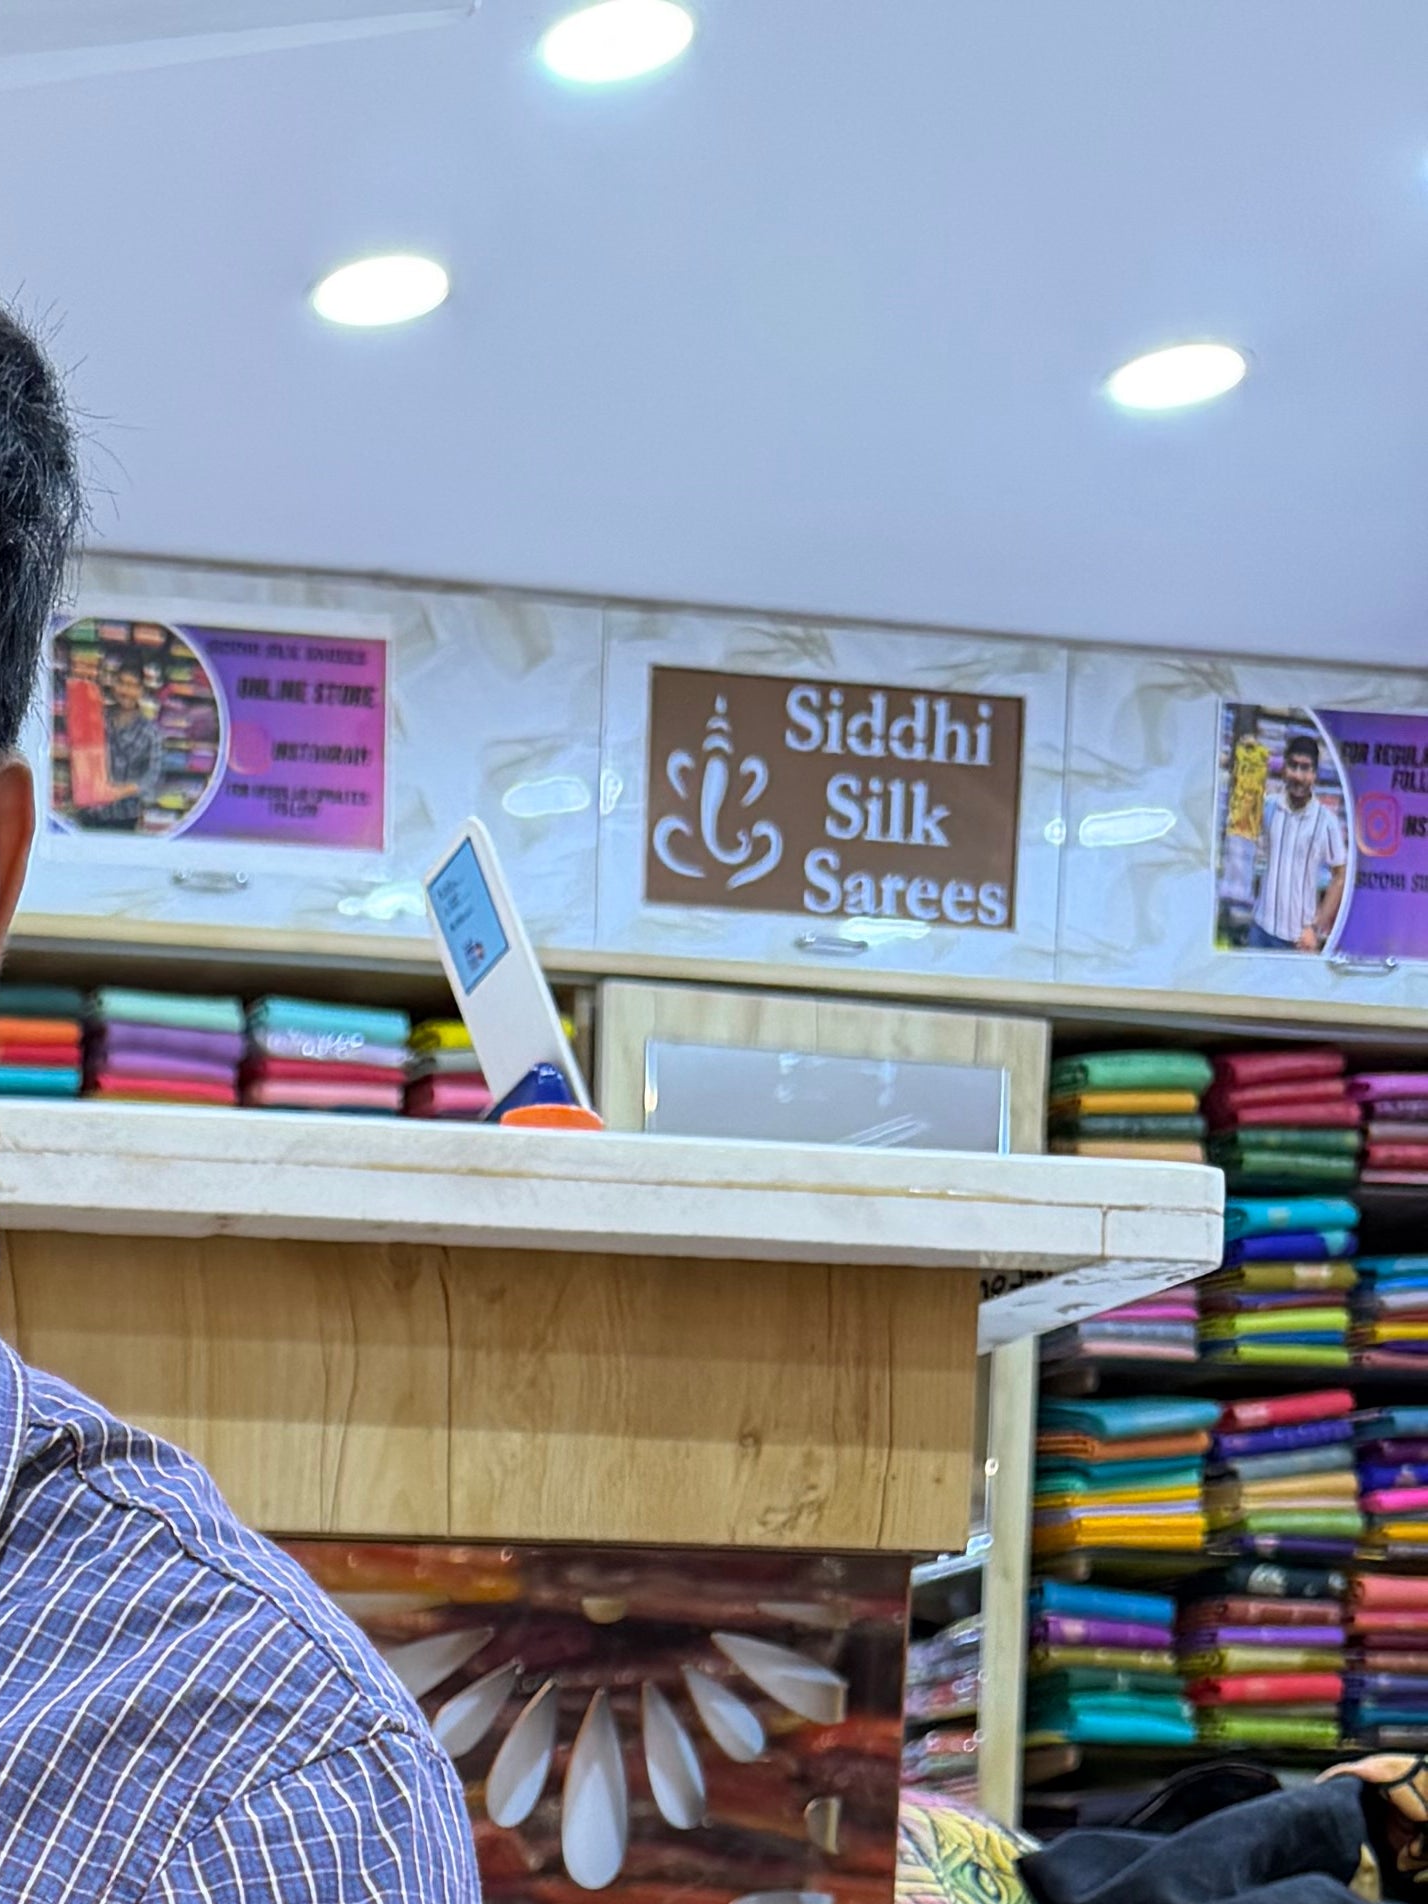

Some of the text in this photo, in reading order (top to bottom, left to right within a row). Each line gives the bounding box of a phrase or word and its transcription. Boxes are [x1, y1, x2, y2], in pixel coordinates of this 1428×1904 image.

[784, 685, 993, 766] Siddhi
[825, 773, 951, 847] Silk
[803, 847, 1008, 925] Sarees
